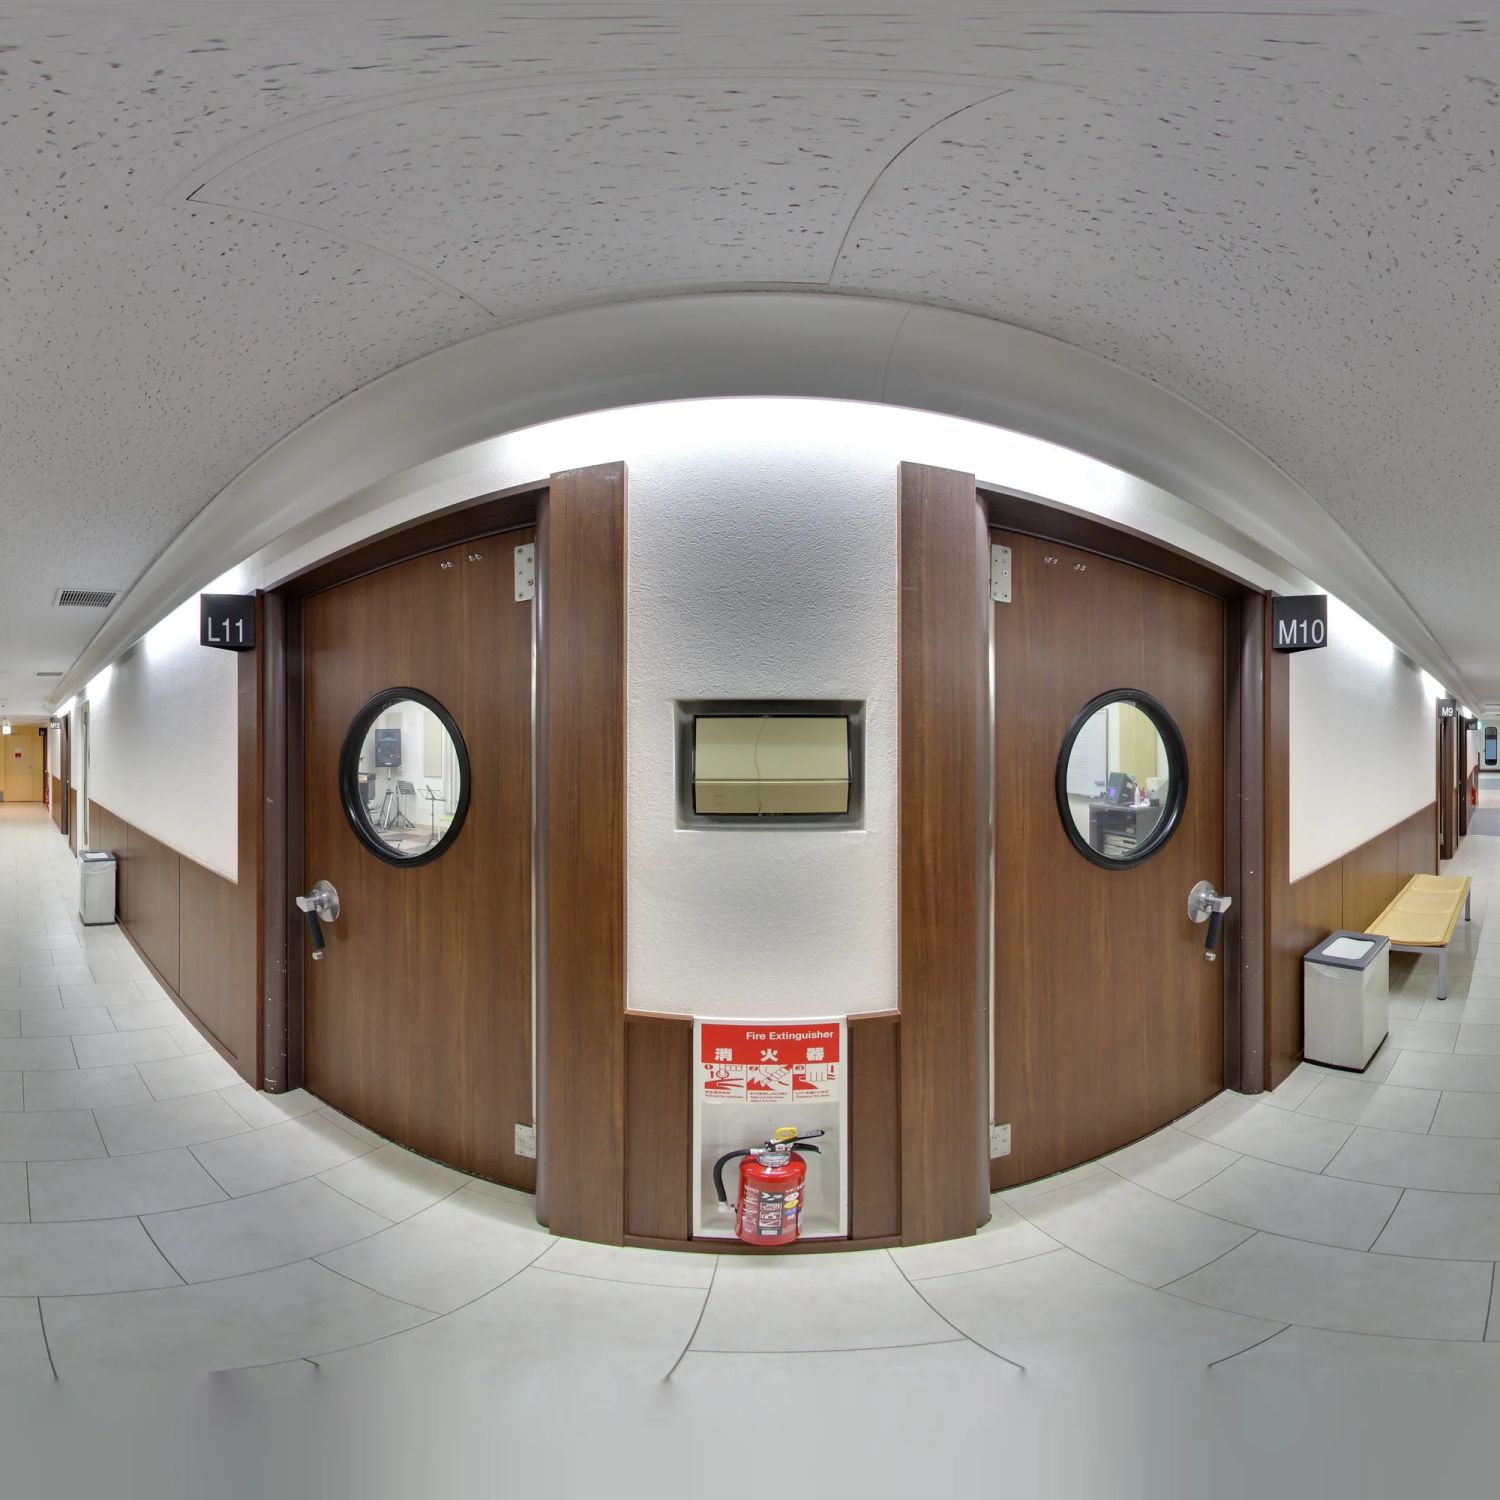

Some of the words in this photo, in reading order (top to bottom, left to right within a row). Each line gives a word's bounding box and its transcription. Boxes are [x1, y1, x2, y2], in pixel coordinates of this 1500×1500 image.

[208, 617, 243, 643] L11
[1279, 619, 1325, 645] M10
[1441, 706, 1454, 717] M9
[746, 1031, 766, 1040] Fire
[769, 1030, 834, 1041] Extinguisher
